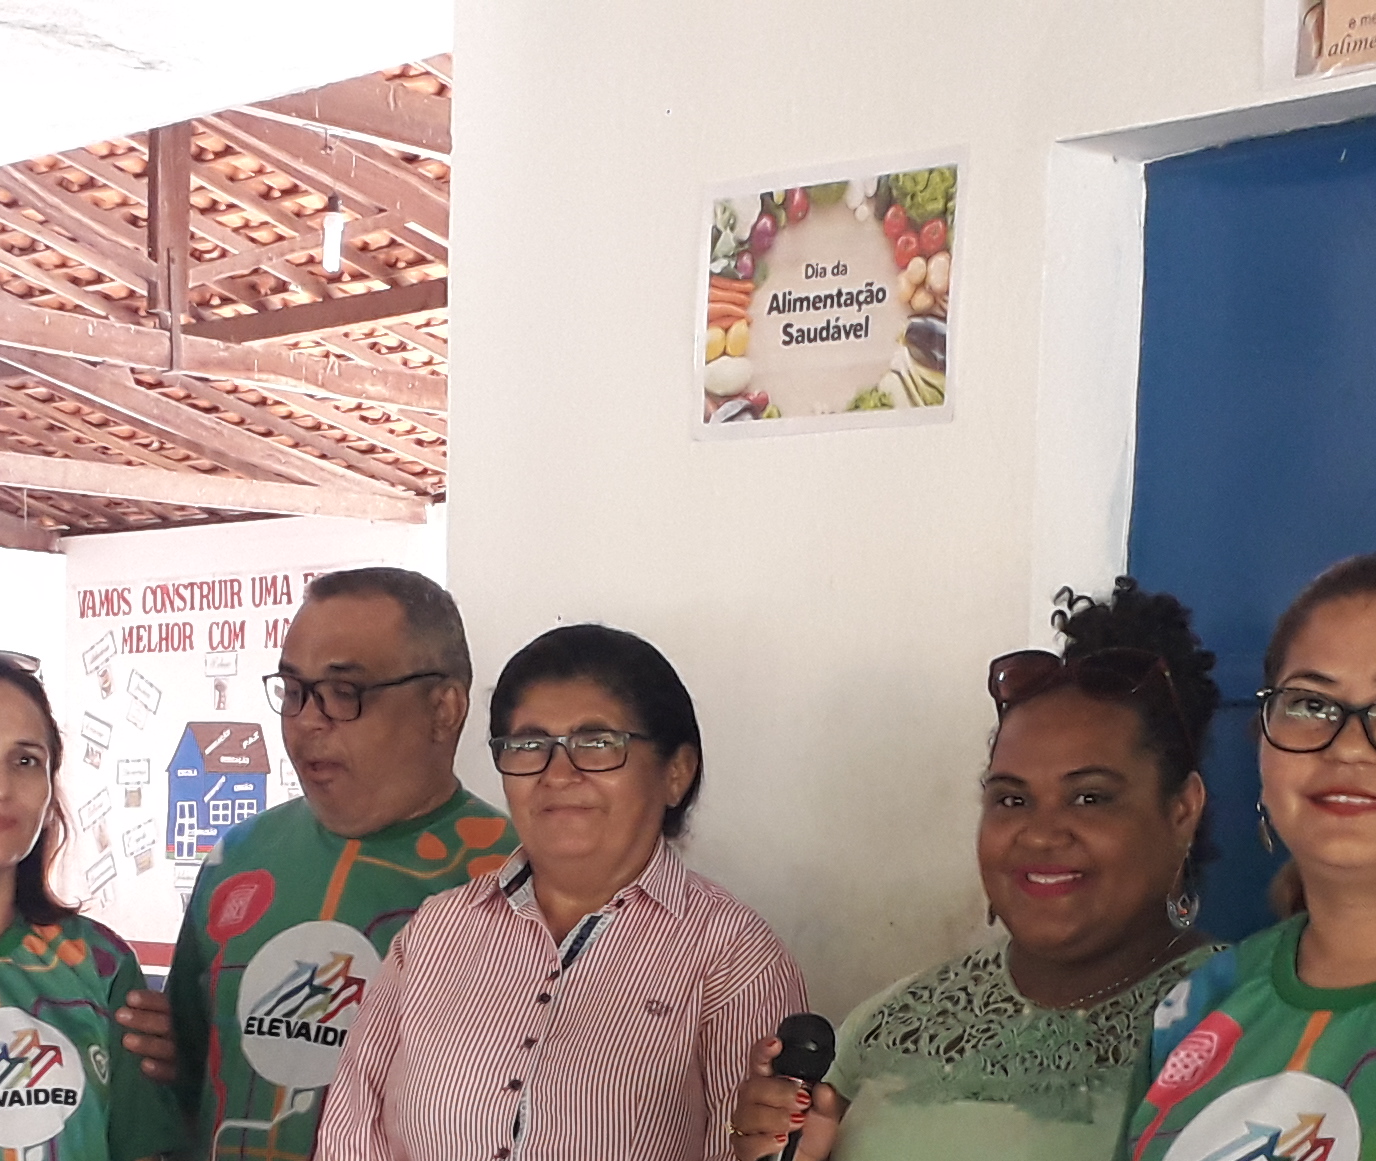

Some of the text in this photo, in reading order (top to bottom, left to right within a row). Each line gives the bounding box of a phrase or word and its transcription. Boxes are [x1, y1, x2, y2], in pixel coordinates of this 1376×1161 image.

[1349, 18, 1356, 29] e
[805, 260, 848, 280] Dia da
[767, 282, 887, 315] Alimentação
[781, 315, 869, 347] Saudável
[77, 574, 293, 619] VAMOS CONSTRUIR UMA
[121, 621, 194, 654] MELHOR
[208, 620, 246, 651] COM
